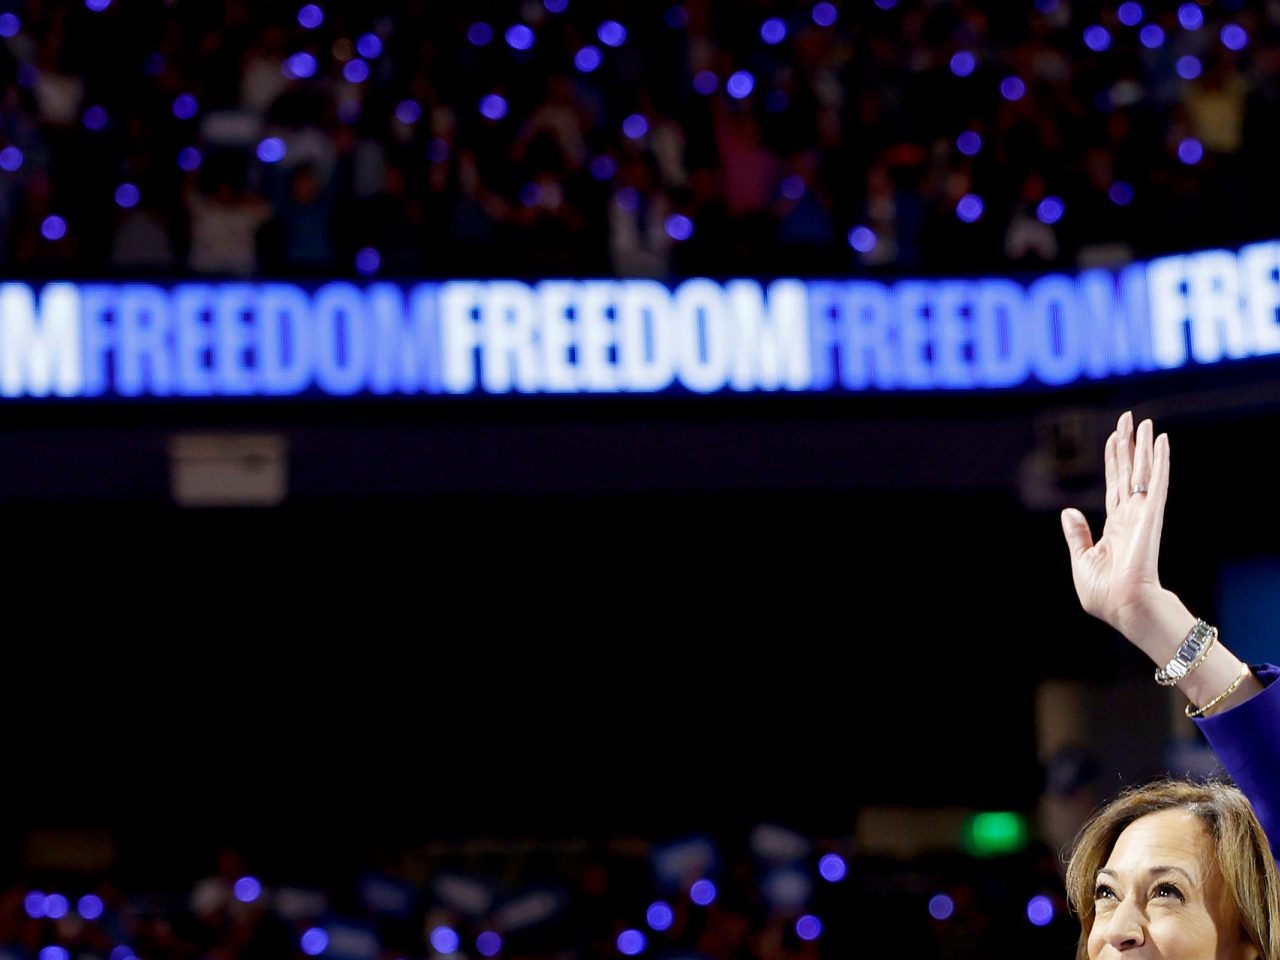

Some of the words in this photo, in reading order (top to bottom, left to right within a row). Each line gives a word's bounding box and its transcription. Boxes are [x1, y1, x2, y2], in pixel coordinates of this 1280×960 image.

[84, 283, 440, 397] FREEDOM
[440, 279, 809, 394] FREEDOM
[810, 264, 1152, 392] FREEDOM
